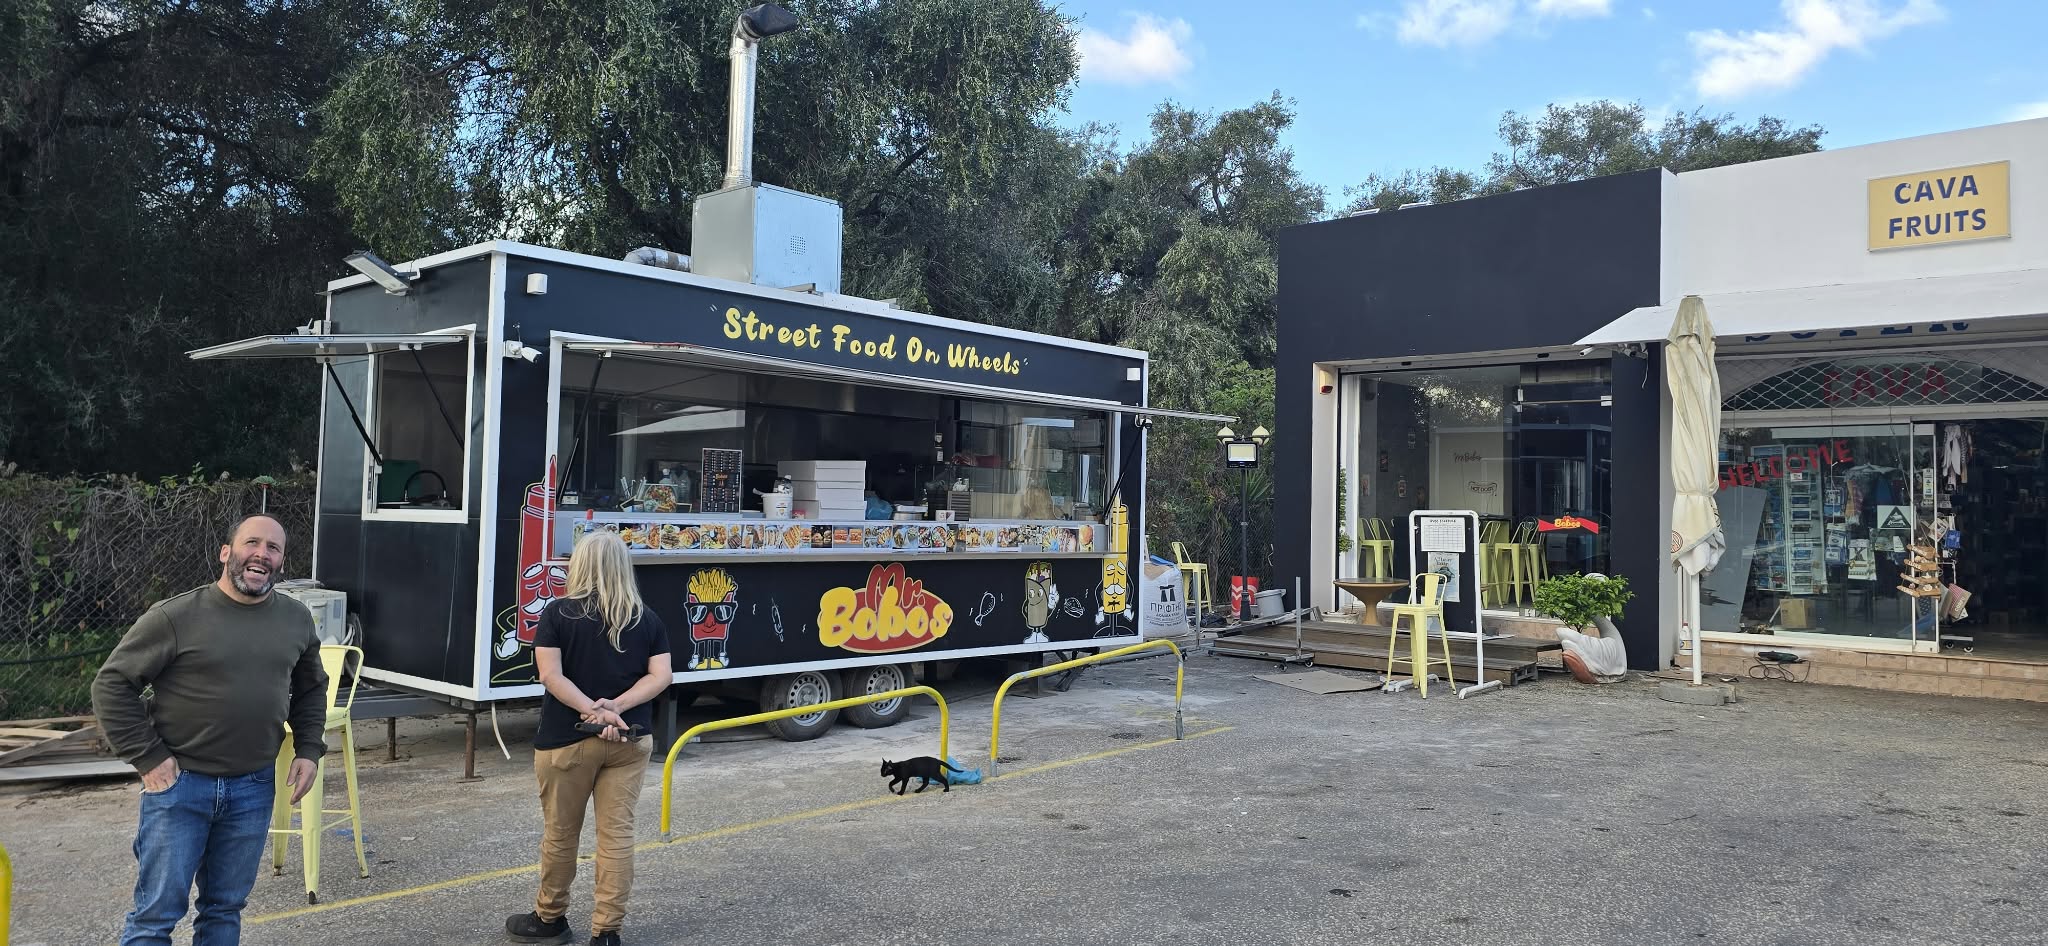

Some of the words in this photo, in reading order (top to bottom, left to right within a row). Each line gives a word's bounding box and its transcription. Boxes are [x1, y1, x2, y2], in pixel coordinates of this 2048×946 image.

[1894, 175, 1978, 205] CAVA
[1889, 208, 1987, 240] FRUITS
[723, 307, 822, 349] Street
[832, 324, 897, 359] Food
[906, 336, 940, 364] On
[948, 343, 1020, 375] Wheels
[1823, 364, 1949, 402] CAVA
[1718, 439, 1854, 492] WELCOME
[865, 562, 925, 613] Mr.
[819, 586, 954, 647] Bobos
